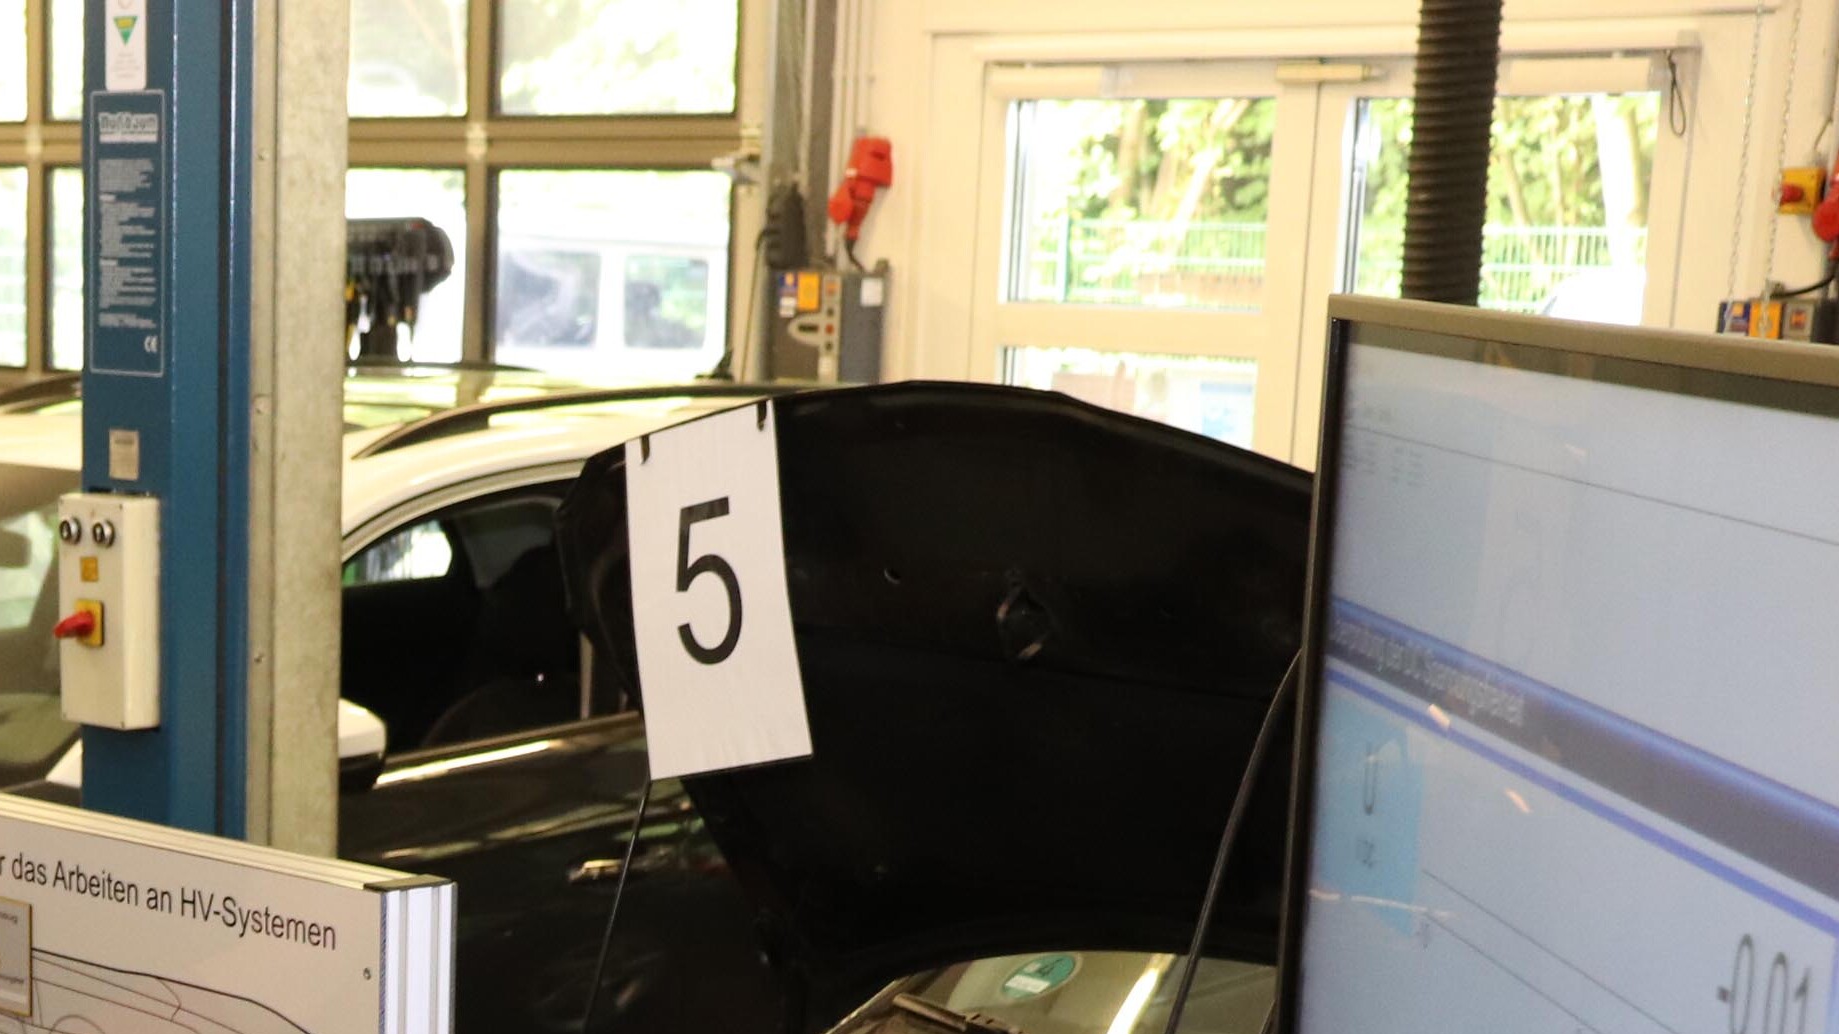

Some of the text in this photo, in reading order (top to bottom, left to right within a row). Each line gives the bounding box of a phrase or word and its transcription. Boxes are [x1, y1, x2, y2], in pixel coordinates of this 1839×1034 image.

[676, 495, 743, 666] 5
[11, 852, 48, 886] das
[52, 860, 139, 907] Arbeiten
[146, 887, 172, 914] an
[180, 886, 337, 951] HV-Systemen
